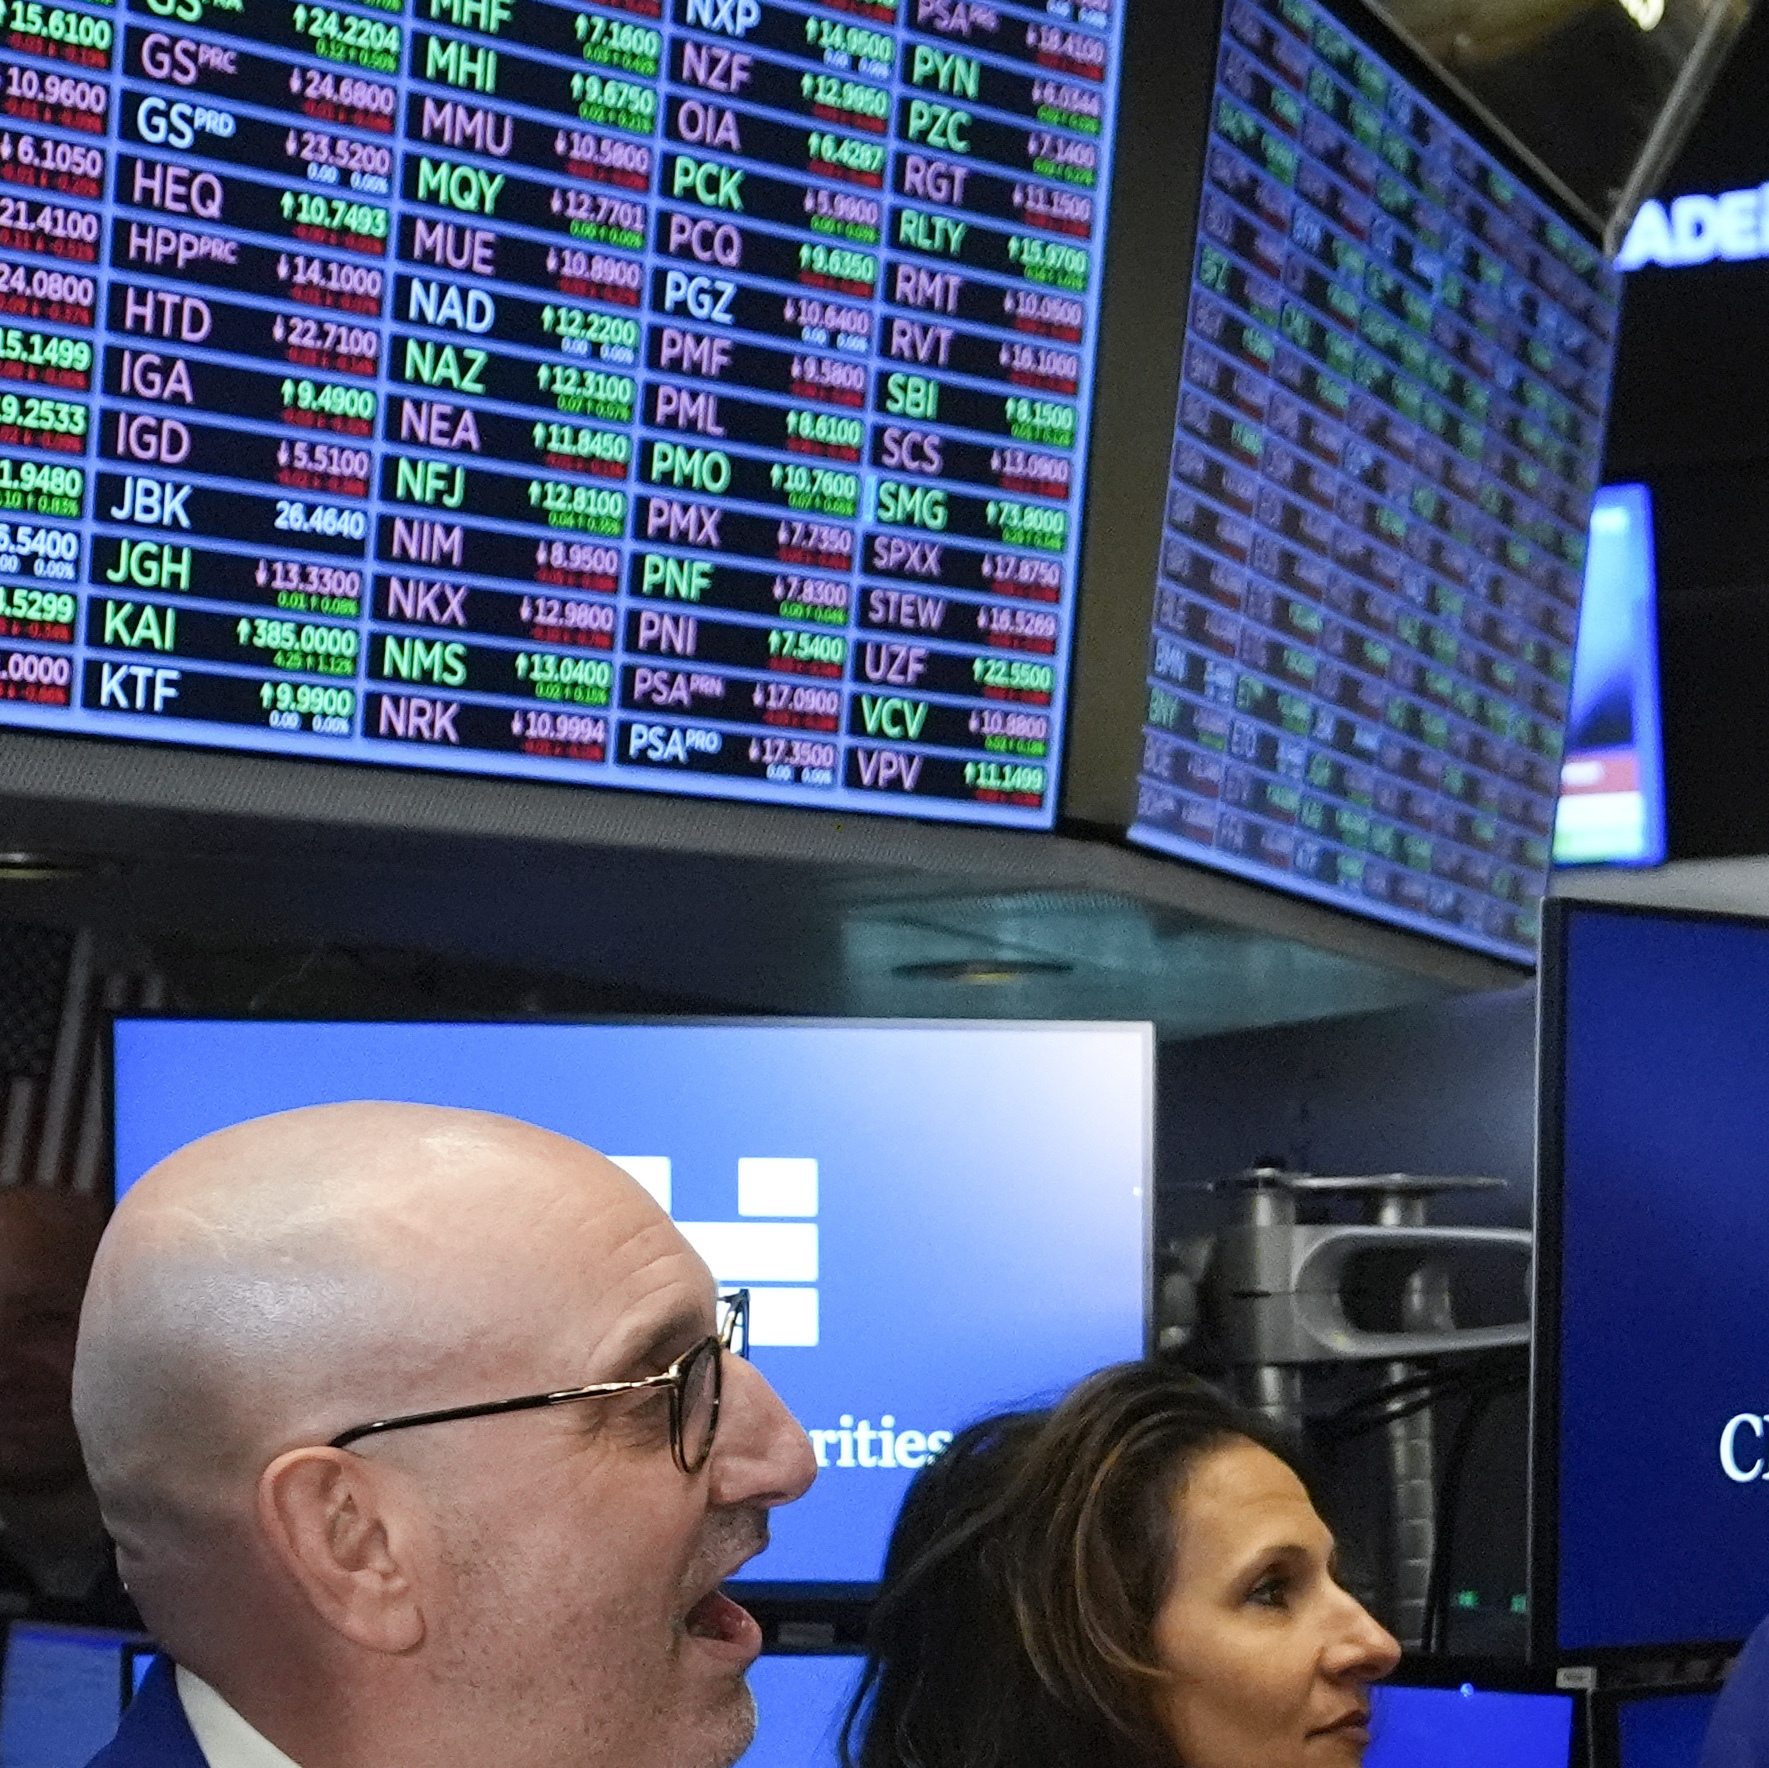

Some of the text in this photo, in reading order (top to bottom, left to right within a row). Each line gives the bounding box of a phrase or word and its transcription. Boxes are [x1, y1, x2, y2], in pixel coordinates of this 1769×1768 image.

[10, 1, 112, 49] 15.6100
[308, 7, 400, 55] 24.2204
[590, 16, 662, 59] 7.1600
[7, 67, 107, 114] 10.9600
[426, 35, 658, 116] MHI 9.6750
[682, 40, 755, 95] NZF
[912, 45, 981, 99] PYN
[422, 96, 514, 157] MMU
[678, 100, 743, 152] OIA
[908, 100, 972, 153] PZC
[17, 136, 103, 178] 6.1050
[300, 131, 392, 176] 23.5200
[904, 154, 970, 206] RGT
[133, 158, 389, 238] HEQ 10.7493
[417, 156, 646, 232] MQY 12.7701
[673, 155, 745, 212] PCK
[0, 198, 98, 243] 21.4100
[413, 218, 497, 276] MUE
[669, 213, 743, 268] PCQ
[900, 209, 968, 256] RLTY
[0, 263, 94, 307] 24.0800
[292, 255, 382, 297] 14.1000
[664, 270, 738, 326] PGZ
[896, 264, 964, 316] RMT
[124, 287, 378, 358] HTD 22.7100
[408, 277, 641, 348] NAD 12.2200
[660, 327, 734, 378] PMF
[891, 318, 954, 366] RVT
[121, 350, 376, 420] IGA 9.4900
[404, 337, 636, 404] NAZ 12.3100
[886, 372, 939, 420] SBI
[0, 395, 87, 436] 9.2533
[400, 398, 632, 464] NEA 11.8450
[655, 384, 864, 449] PML 8.6100
[117, 411, 370, 479] IGD 5.5100
[651, 441, 861, 500] PMO 10.7600
[881, 428, 943, 475] SCS
[110, 475, 368, 540] JBK 26.4640
[396, 456, 628, 519] NFJ 12.8100
[877, 481, 949, 531] SMG
[392, 517, 620, 577] NIM 8.9500
[647, 497, 723, 549] PMX
[106, 538, 361, 598] JGH 13.3300
[642, 554, 850, 608] PNF 7.8300
[872, 535, 945, 577] SPXX
[104, 600, 359, 658] KAI 385.0000
[387, 576, 614, 632] NKX 12.9800
[868, 589, 947, 631] STEW
[383, 634, 613, 688] NMS 13.0400
[638, 610, 847, 666] PNI 7.5400
[100, 662, 356, 717] KTF 9.9900
[865, 642, 1054, 693] UZF 22.5500
[379, 694, 606, 745] NRK 10.9994
[861, 694, 928, 741] VCV
[762, 738, 836, 770] 17.3500
[857, 748, 1045, 795] VPV 11.1499
